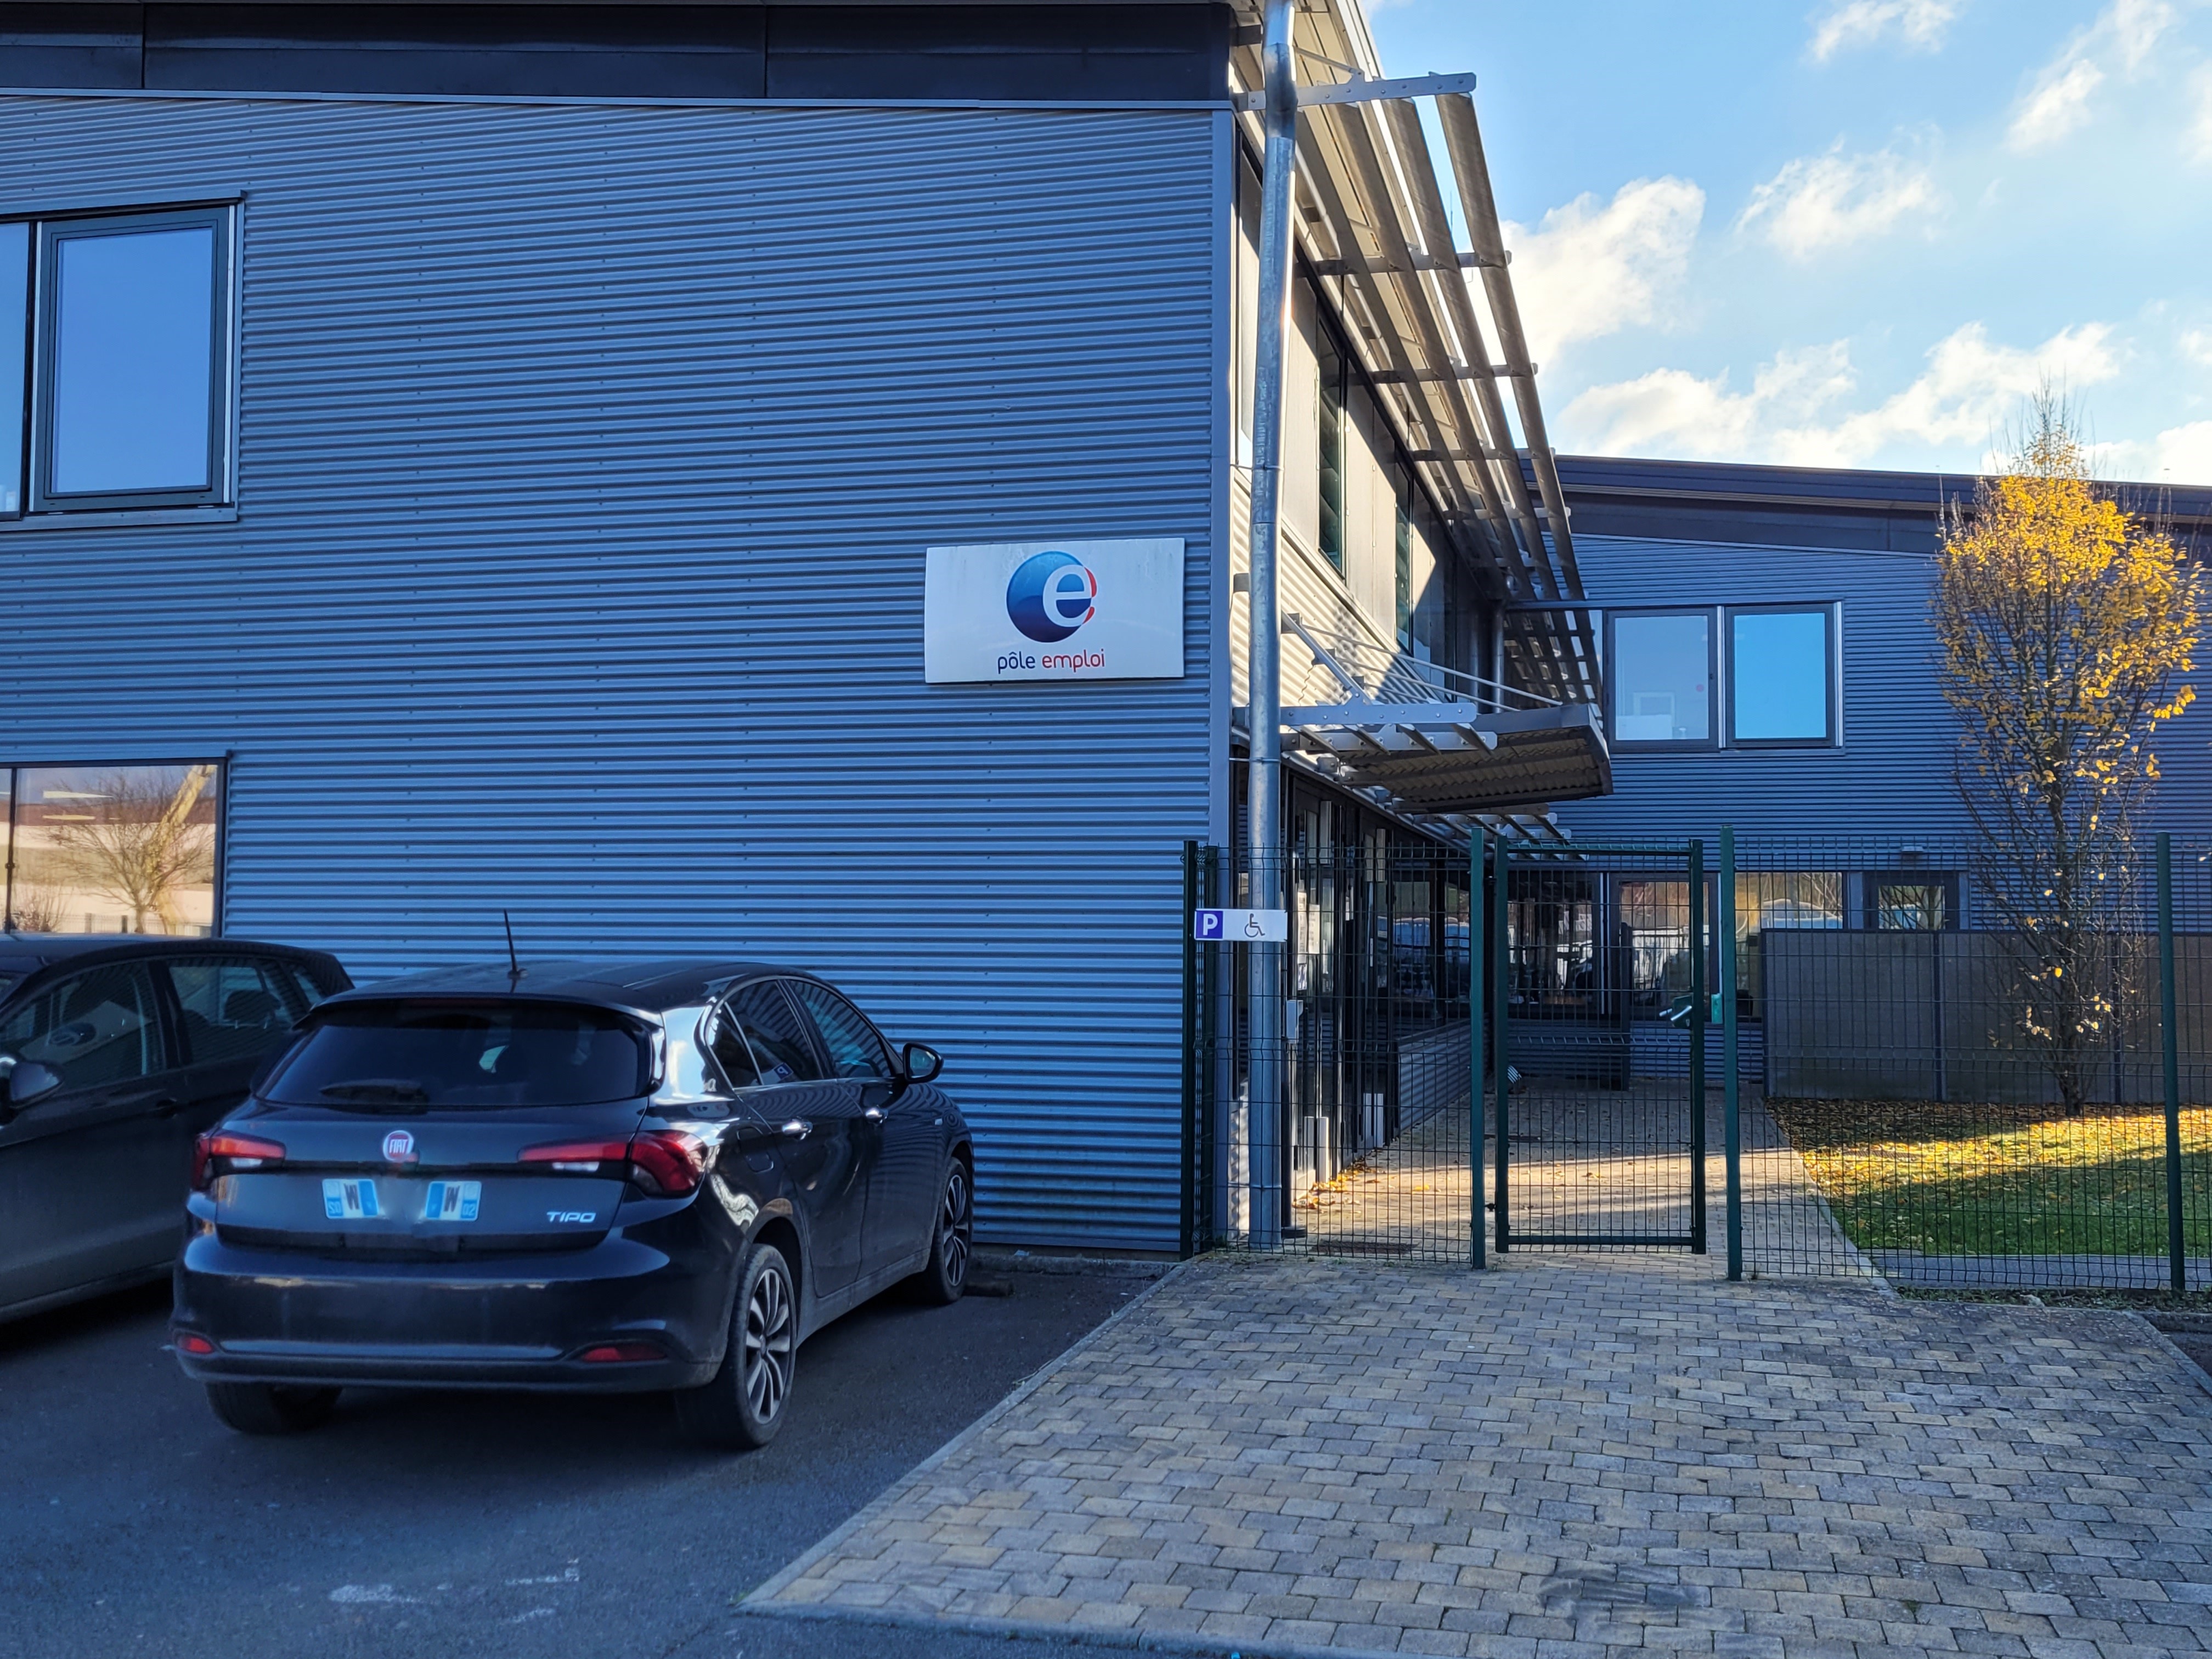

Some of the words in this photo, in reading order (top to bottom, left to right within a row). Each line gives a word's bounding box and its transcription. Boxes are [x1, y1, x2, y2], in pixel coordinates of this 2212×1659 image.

[1043, 564, 1097, 628] e
[997, 651, 1036, 674] pôle
[1042, 648, 1105, 673] emploi
[1203, 913, 1218, 935] P
[390, 1139, 408, 1154] FIAT
[546, 1211, 596, 1223] TIPO
